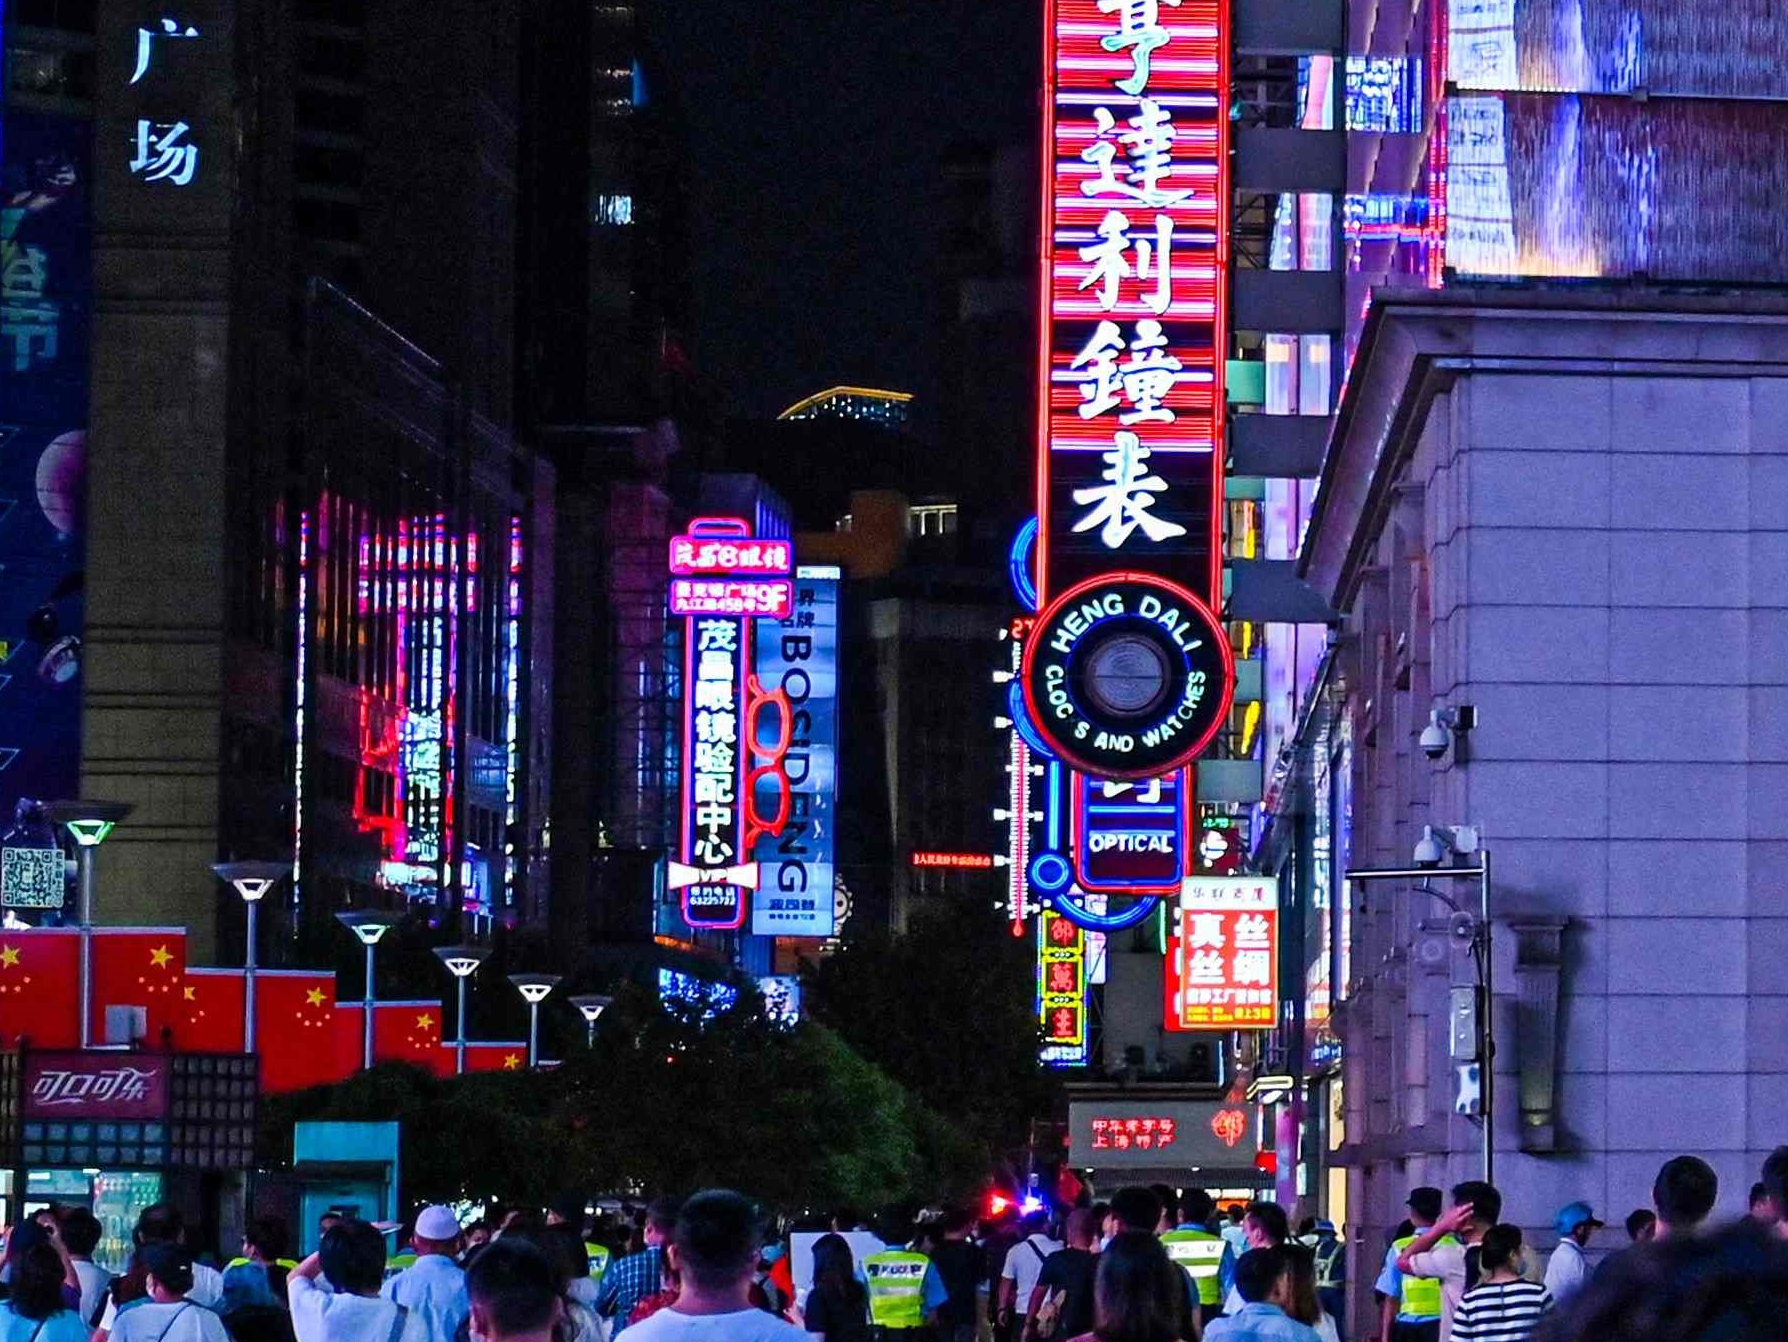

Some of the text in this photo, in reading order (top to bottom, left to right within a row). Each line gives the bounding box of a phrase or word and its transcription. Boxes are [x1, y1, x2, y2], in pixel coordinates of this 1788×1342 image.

[1052, 593, 1203, 654] HENG DALI
[1045, 664, 1206, 753] CLOCS AND WATCHES
[1088, 833, 1174, 853] OPTICAL
[32, 1067, 157, 1106] 可口可乐
[1091, 1135, 1174, 1150] 上海特产
